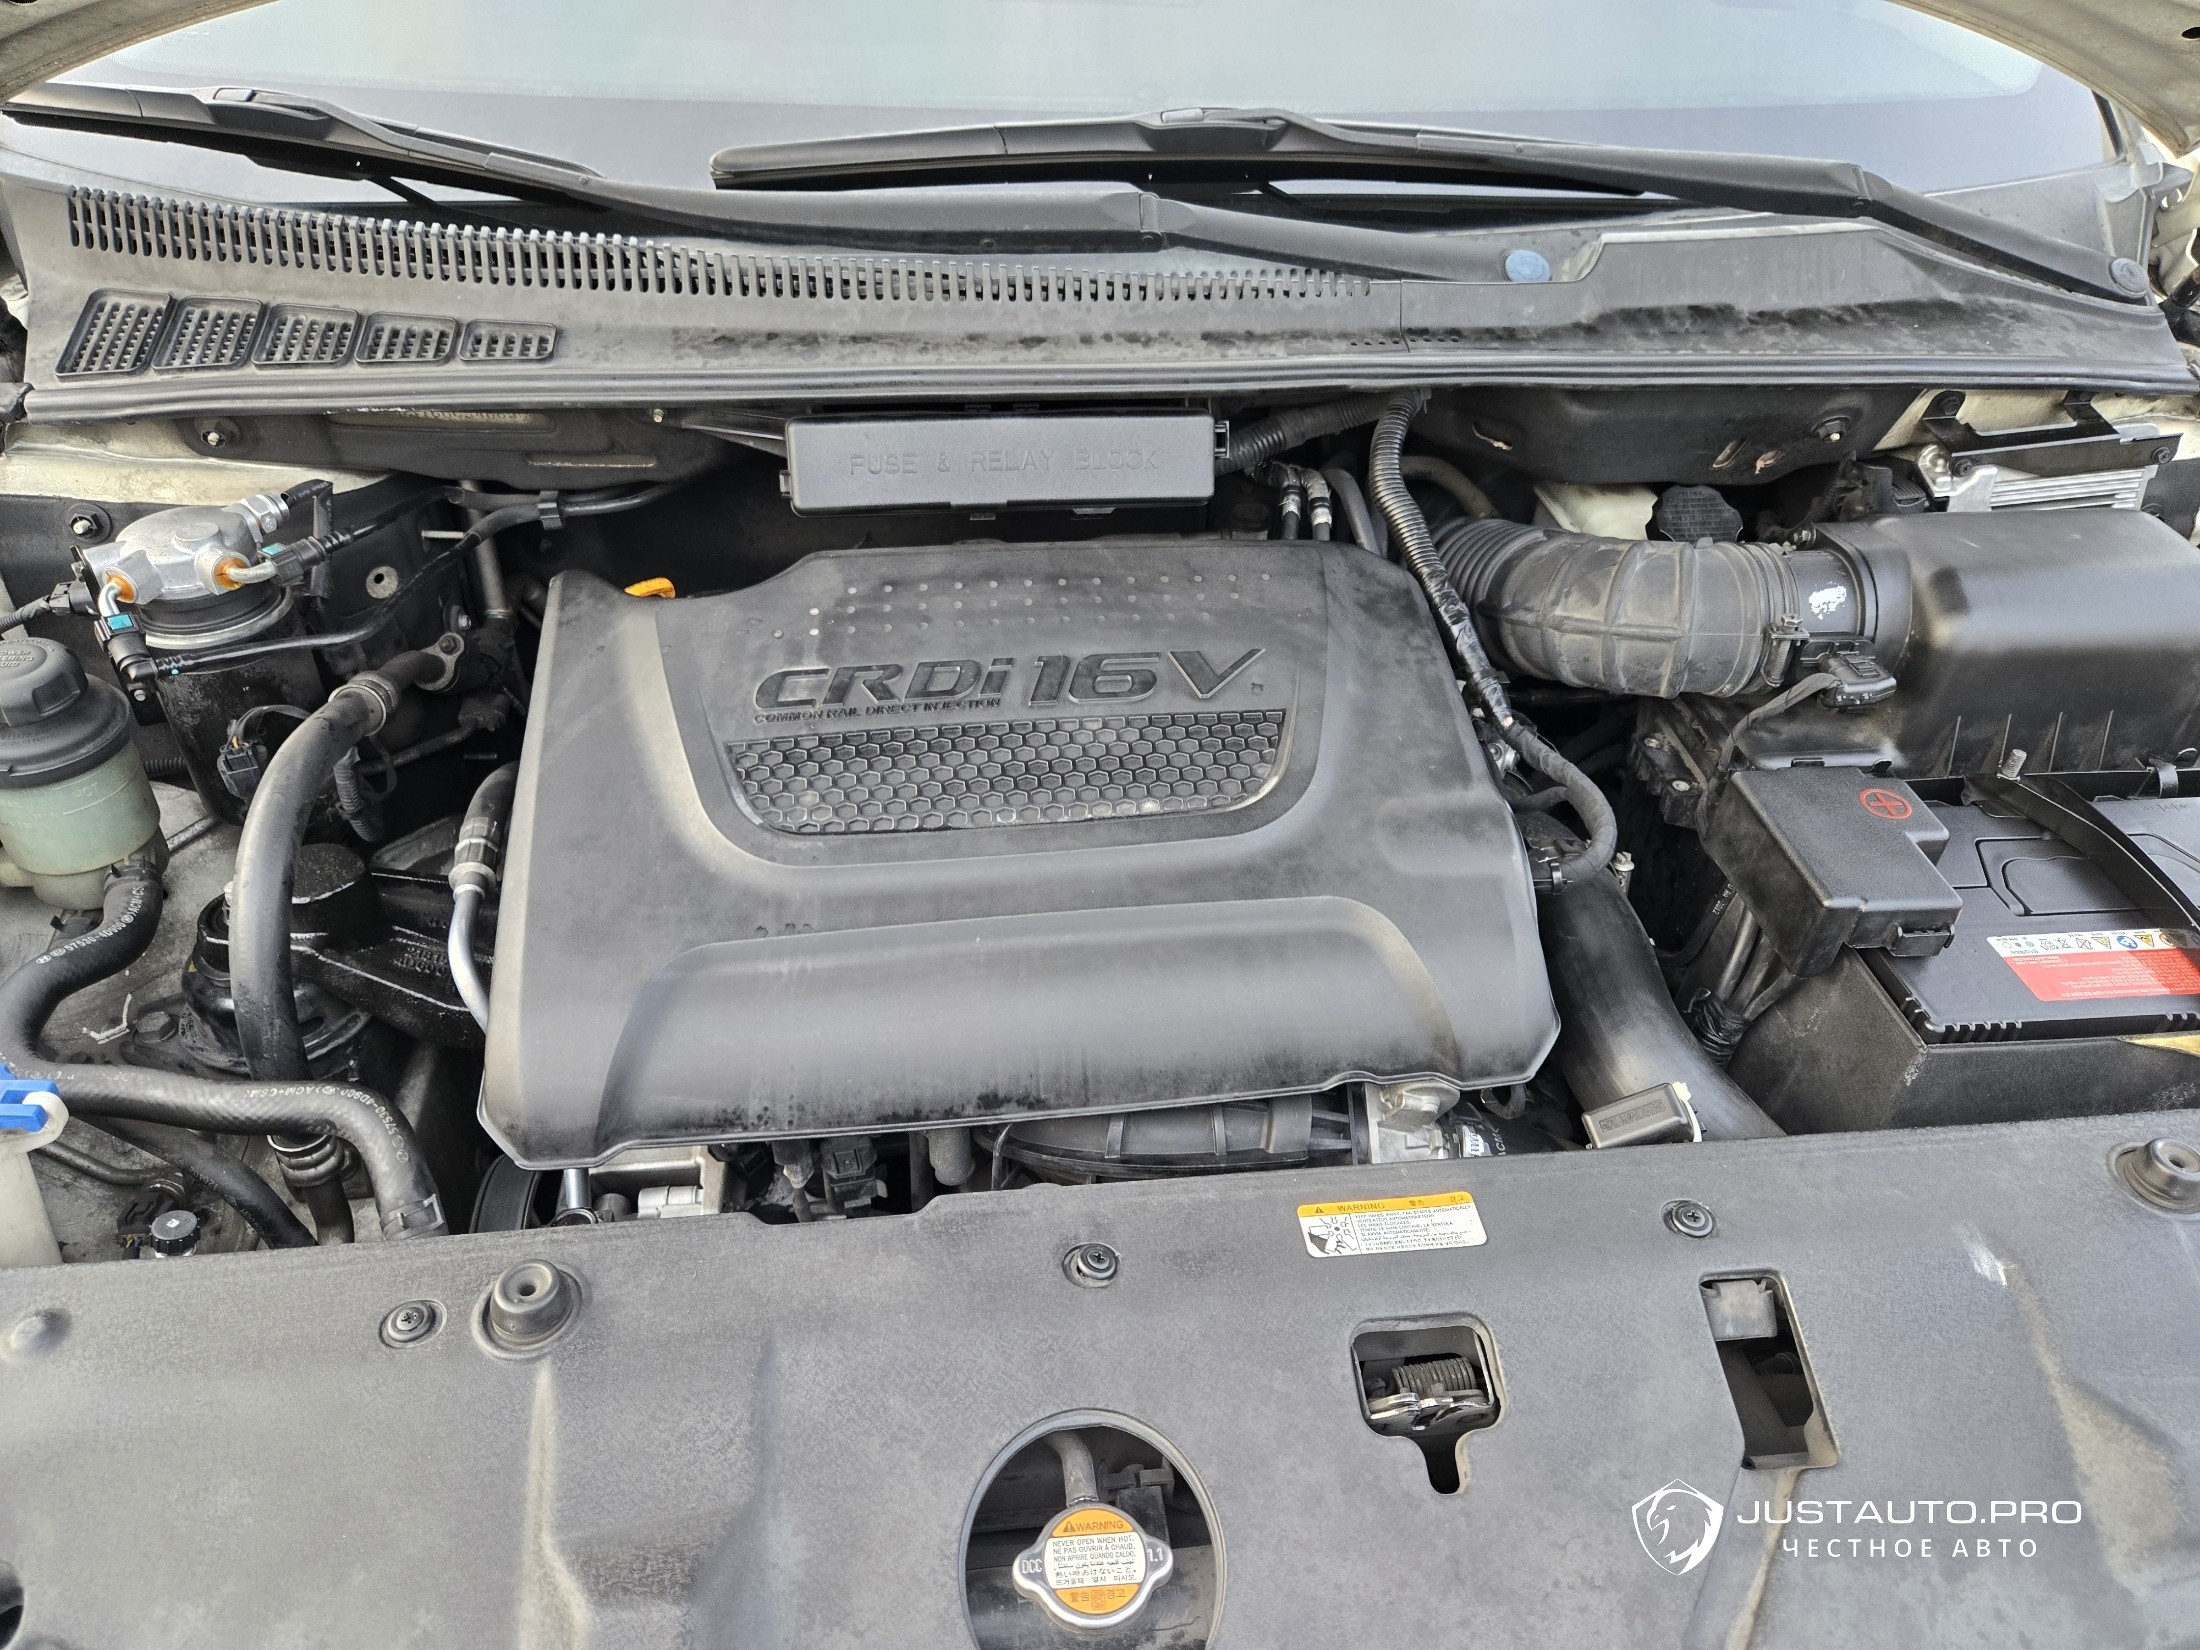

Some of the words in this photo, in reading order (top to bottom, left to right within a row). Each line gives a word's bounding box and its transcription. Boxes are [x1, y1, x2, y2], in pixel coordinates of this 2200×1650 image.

[850, 453, 918, 476] FUSE
[937, 451, 951, 474] &
[971, 449, 1056, 473] RELAY
[1075, 448, 1158, 471] BLOCK
[754, 657, 1014, 711] CRDi
[1028, 648, 1267, 708] 16V
[752, 709, 823, 725] COMMON
[825, 706, 861, 719] RAIL
[864, 702, 920, 715] DIRECT
[922, 698, 1002, 713] INJECTION
[1336, 1202, 1386, 1213] WARNING
[1075, 1520, 1124, 1532] WARNING
[1052, 1540, 1075, 1548] NEVER
[1096, 1536, 1116, 1544] WHEN
[1118, 1535, 1135, 1543] HOT.
[1053, 1547, 1063, 1555] NE
[1063, 1546, 1077, 1554] PAS
[1078, 1545, 1103, 1553] OUVRIR
[1110, 1542, 1136, 1551] CHAUD.
[1053, 1555, 1066, 1563] NON
[1067, 1553, 1088, 1561] APRIRE
[1089, 1551, 1114, 1560] QUANDO
[1115, 1550, 1137, 1558] CALDO.
[1147, 1547, 1164, 1562] 1.1
[1021, 1558, 1043, 1574] DCC
